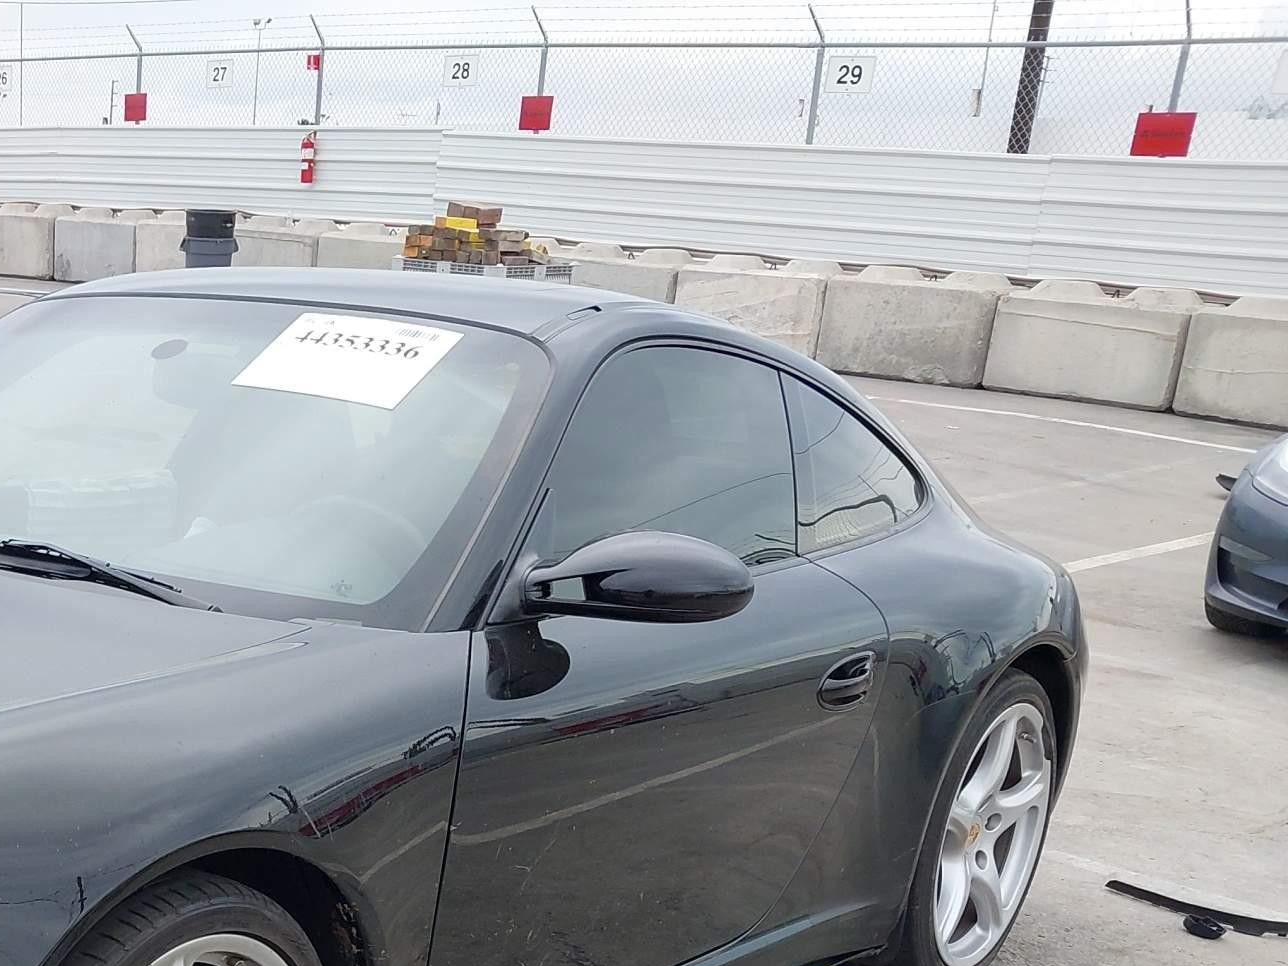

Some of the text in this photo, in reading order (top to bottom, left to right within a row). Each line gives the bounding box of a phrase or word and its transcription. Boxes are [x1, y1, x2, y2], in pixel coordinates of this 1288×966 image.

[212, 66, 227, 82] 27
[451, 62, 470, 80] 28
[836, 64, 863, 86] 29
[296, 329, 425, 360] 44353336
